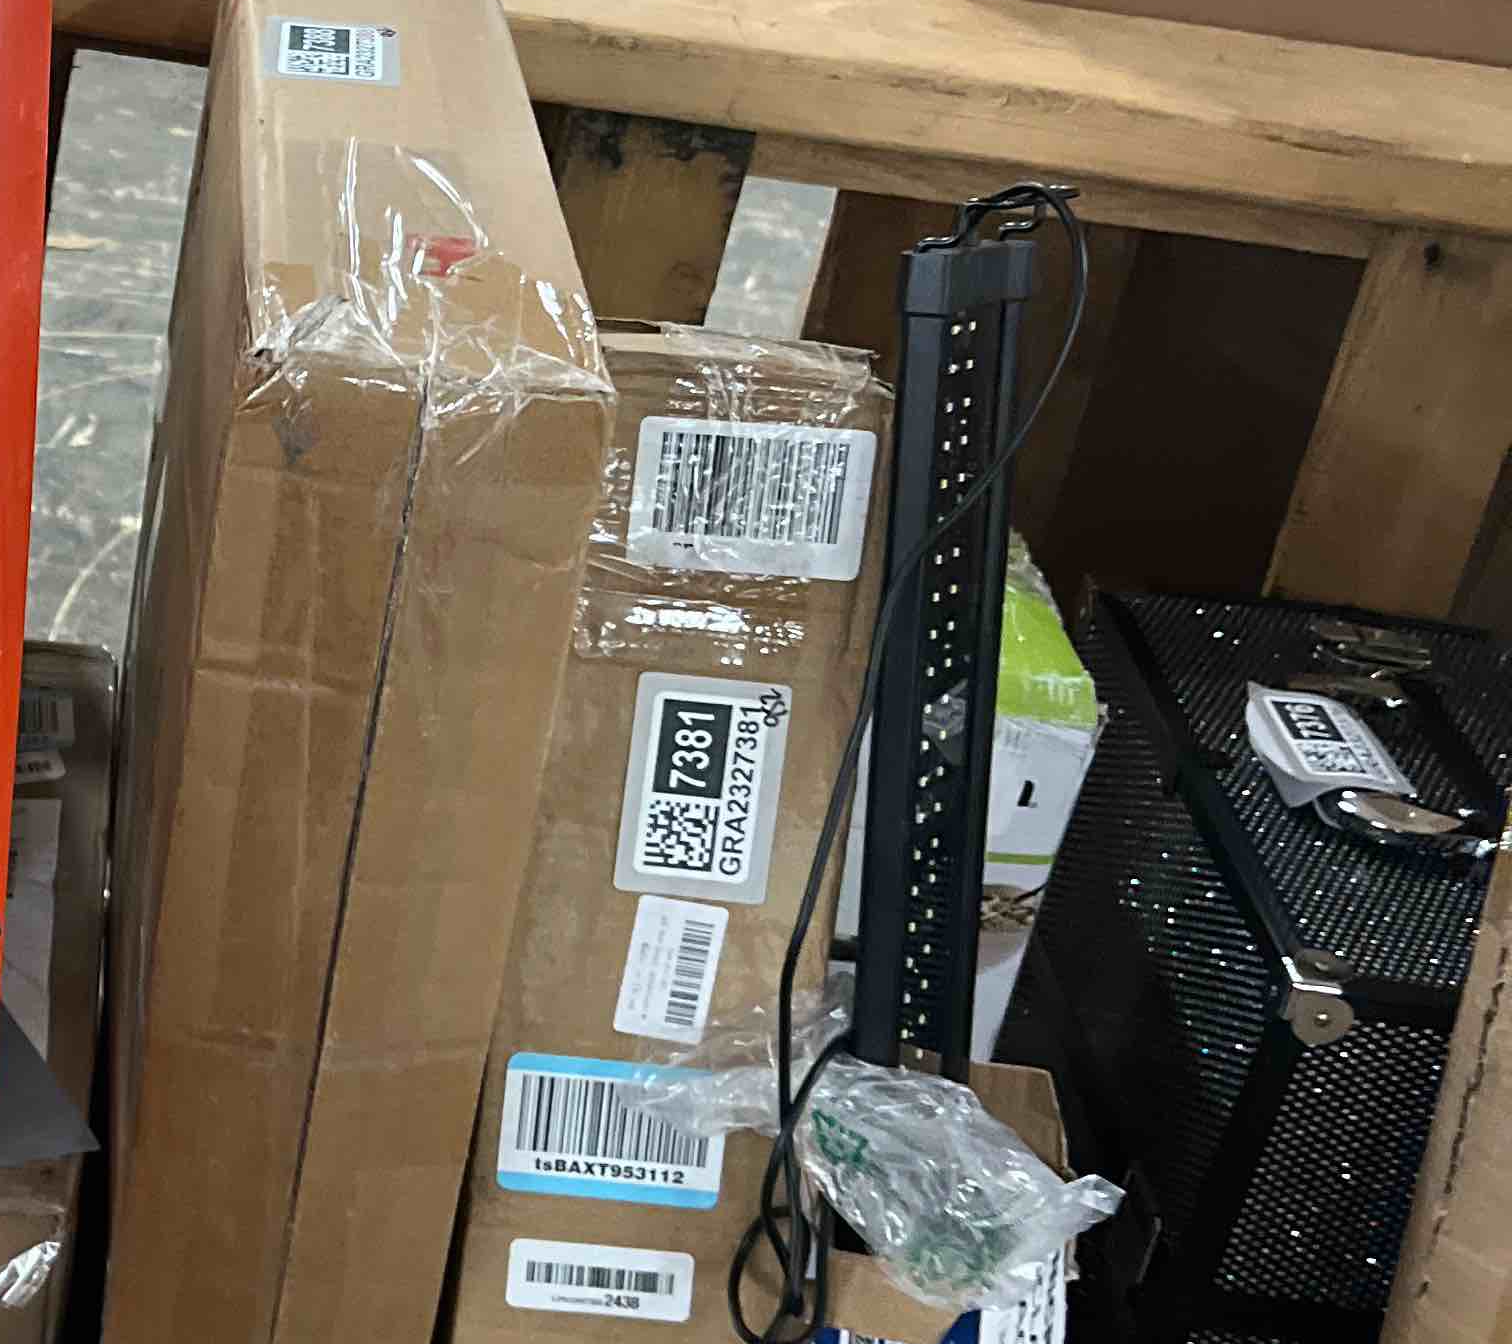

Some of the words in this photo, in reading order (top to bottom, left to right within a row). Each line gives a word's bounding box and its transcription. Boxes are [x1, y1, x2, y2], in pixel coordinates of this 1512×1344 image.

[669, 710, 716, 789] 7381
[719, 705, 763, 876] GRA2327381
[534, 1156, 686, 1185] tsBAXT953112
